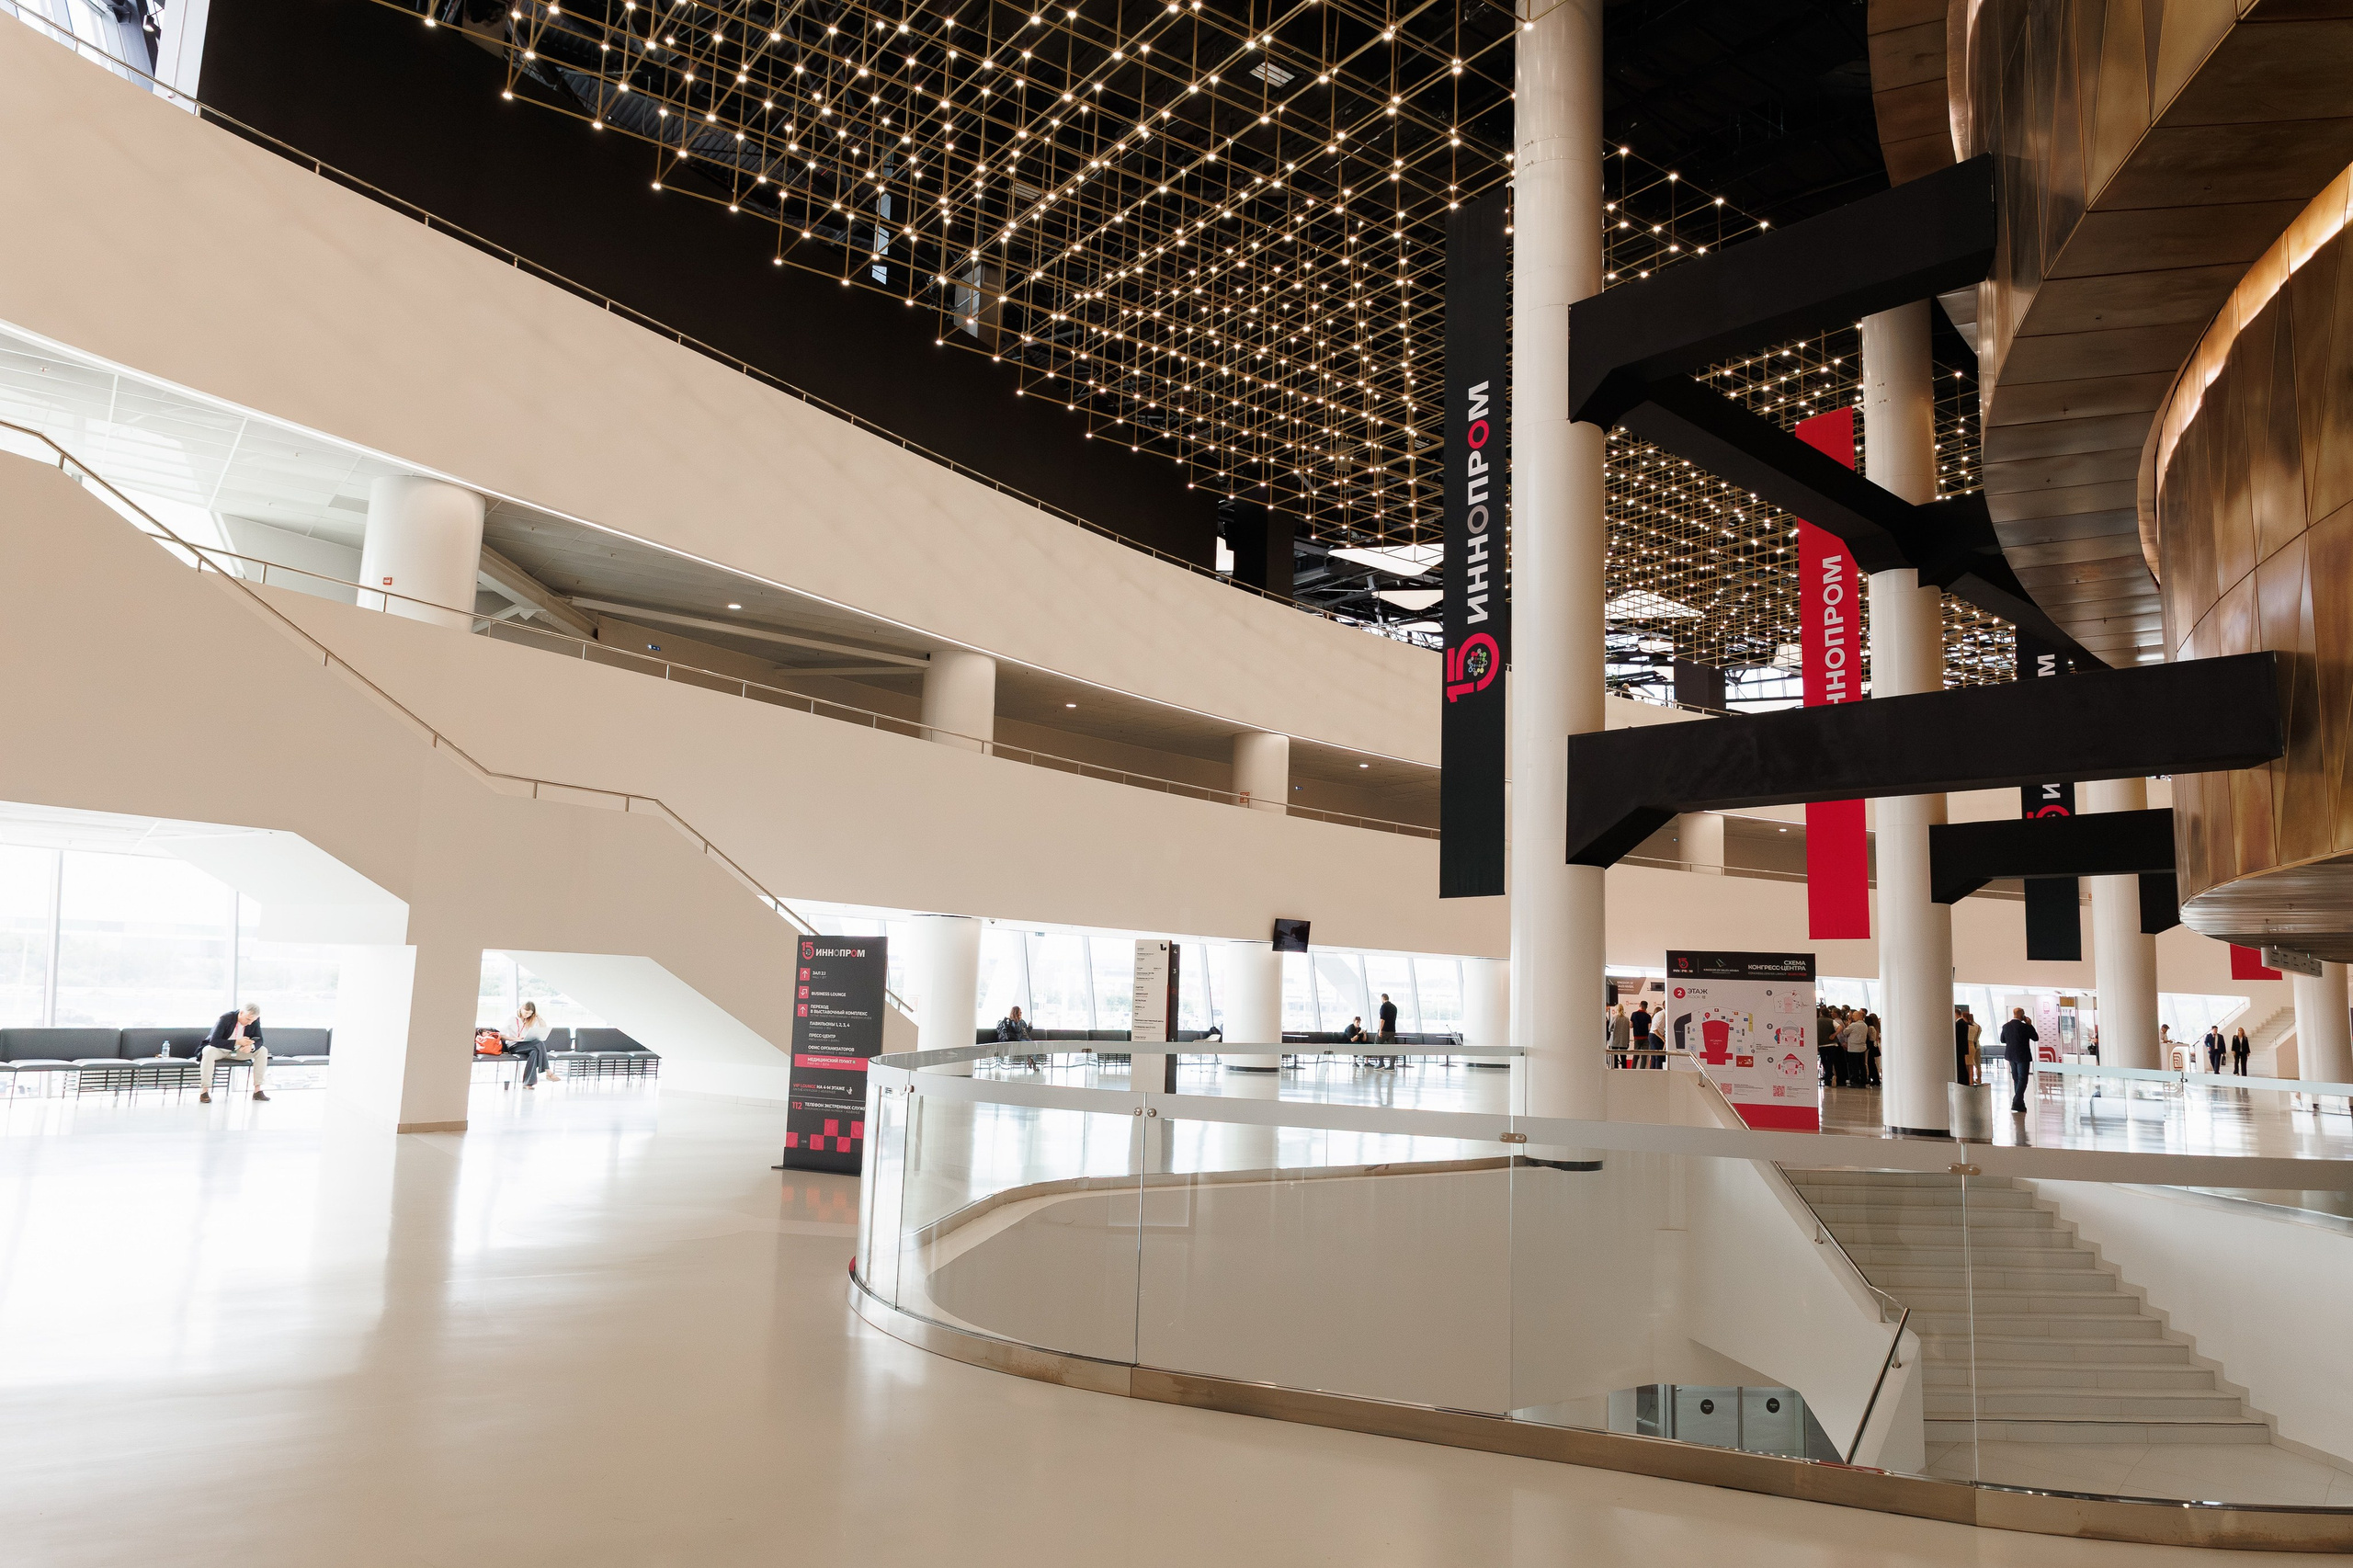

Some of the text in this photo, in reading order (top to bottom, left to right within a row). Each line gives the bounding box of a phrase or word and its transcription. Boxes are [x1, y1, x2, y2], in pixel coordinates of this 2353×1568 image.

[1447, 380, 1500, 703] 15 ИННОПРОМ
[1822, 554, 1847, 705] ННОПРОМ
[801, 941, 866, 960] 15 ИННОПРОМ
[791, 1101, 802, 1110] 112
